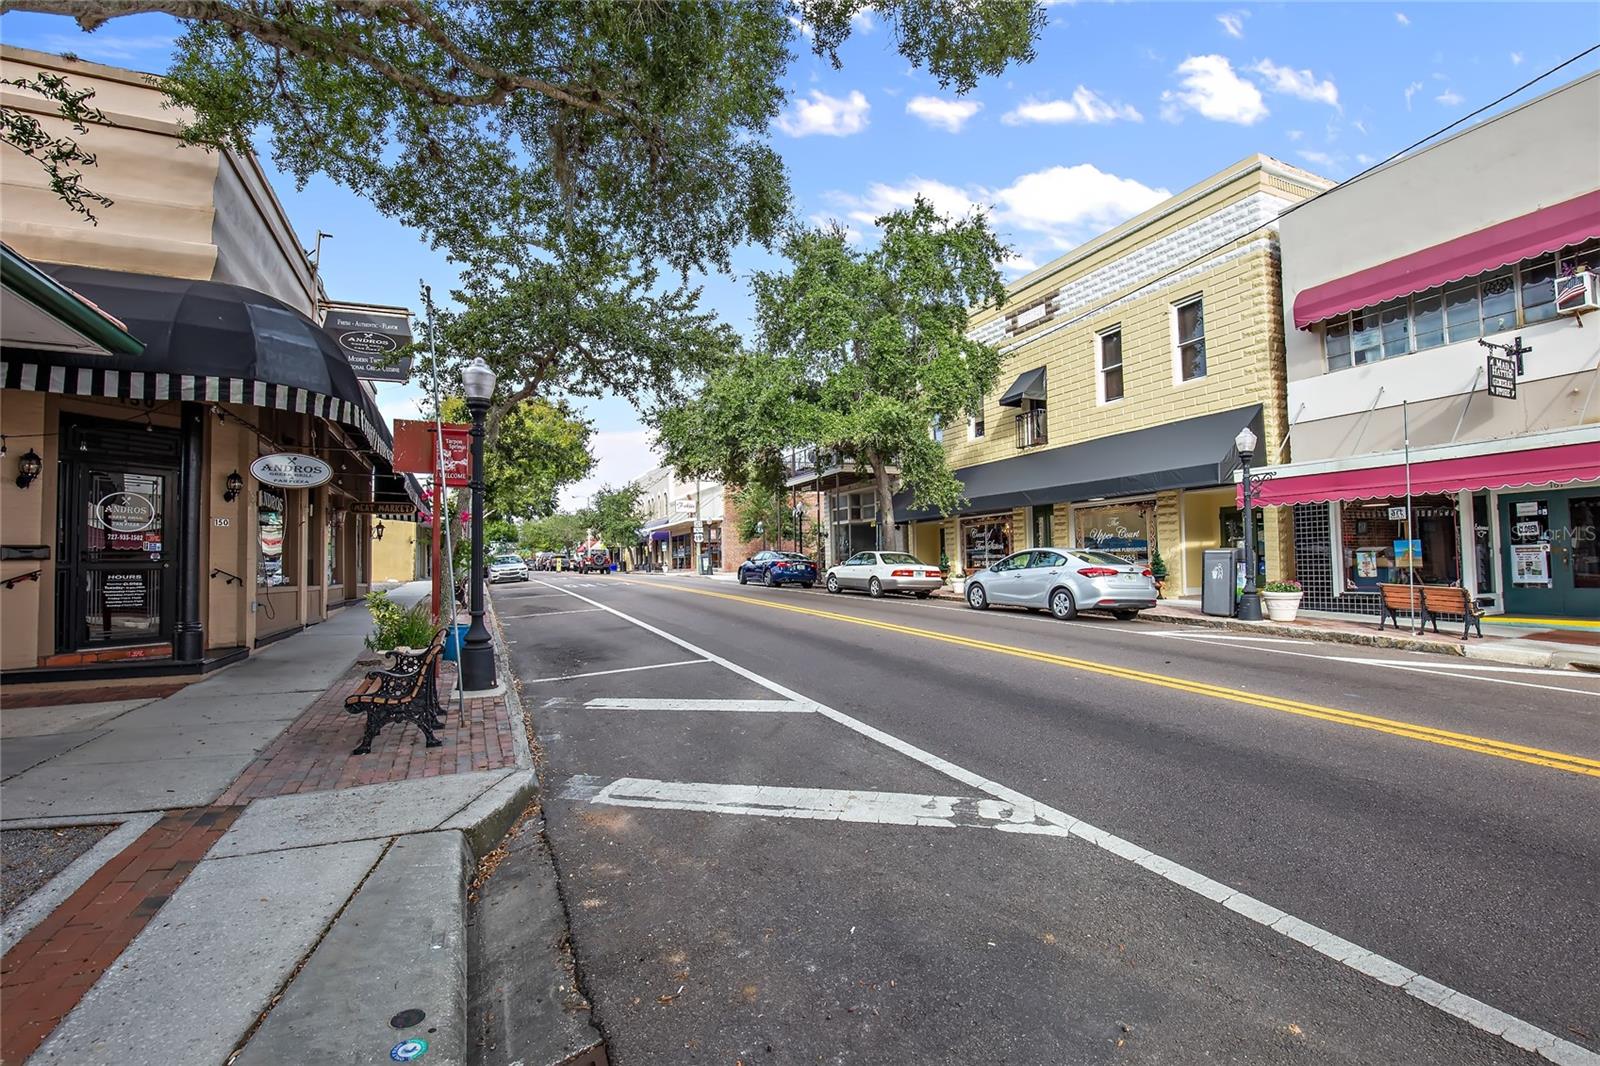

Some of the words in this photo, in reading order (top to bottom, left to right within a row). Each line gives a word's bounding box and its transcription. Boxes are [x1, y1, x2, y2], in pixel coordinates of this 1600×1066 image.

[348, 337, 389, 346] ANDROS
[1496, 358, 1510, 370] MAD
[1492, 365, 1514, 379] HATTER
[261, 464, 323, 474] ANDROS
[263, 491, 284, 511] NDROS
[104, 505, 148, 514] ANDROS
[377, 504, 410, 513] MARKET
[215, 518, 229, 526] 150
[1089, 527, 1115, 544] Upper
[1115, 525, 1140, 540] Court
